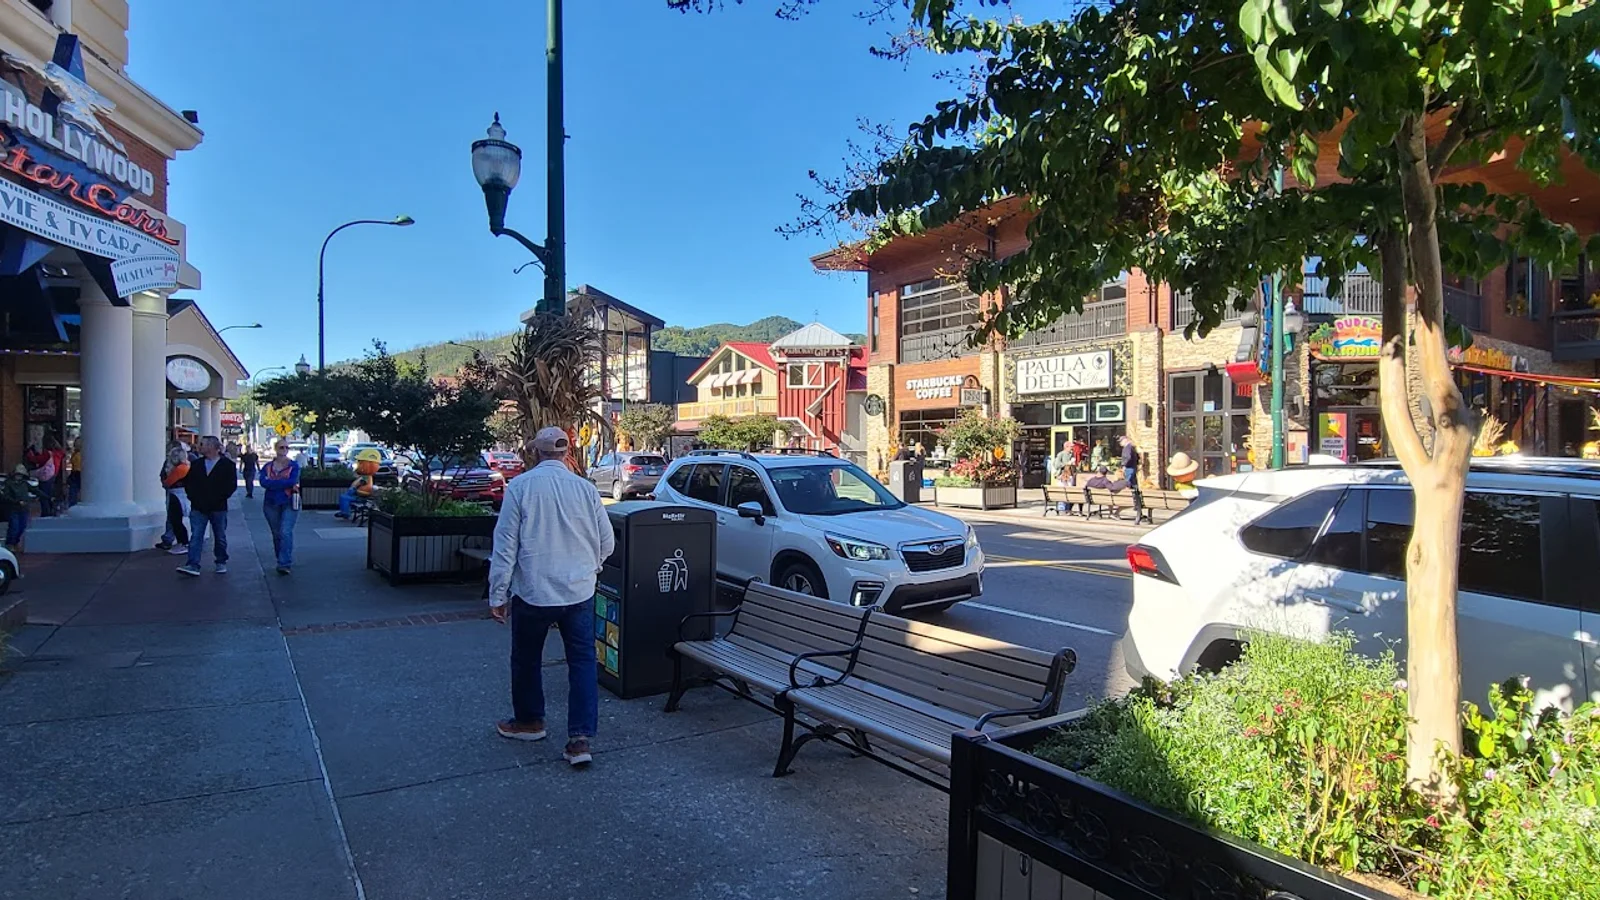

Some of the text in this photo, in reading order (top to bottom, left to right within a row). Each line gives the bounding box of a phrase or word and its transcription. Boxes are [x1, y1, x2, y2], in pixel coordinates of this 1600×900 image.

[5, 89, 154, 198] HOLLYWOOD
[87, 183, 180, 246] Cars
[45, 210, 60, 230] &
[67, 218, 92, 241] TV
[96, 228, 142, 255] CARS
[116, 266, 154, 285] MUSEUM
[1025, 356, 1086, 375] PAULA
[905, 375, 963, 390] STARBUCKS
[1025, 371, 1082, 390] DEEN
[915, 387, 952, 399] COFFEE
